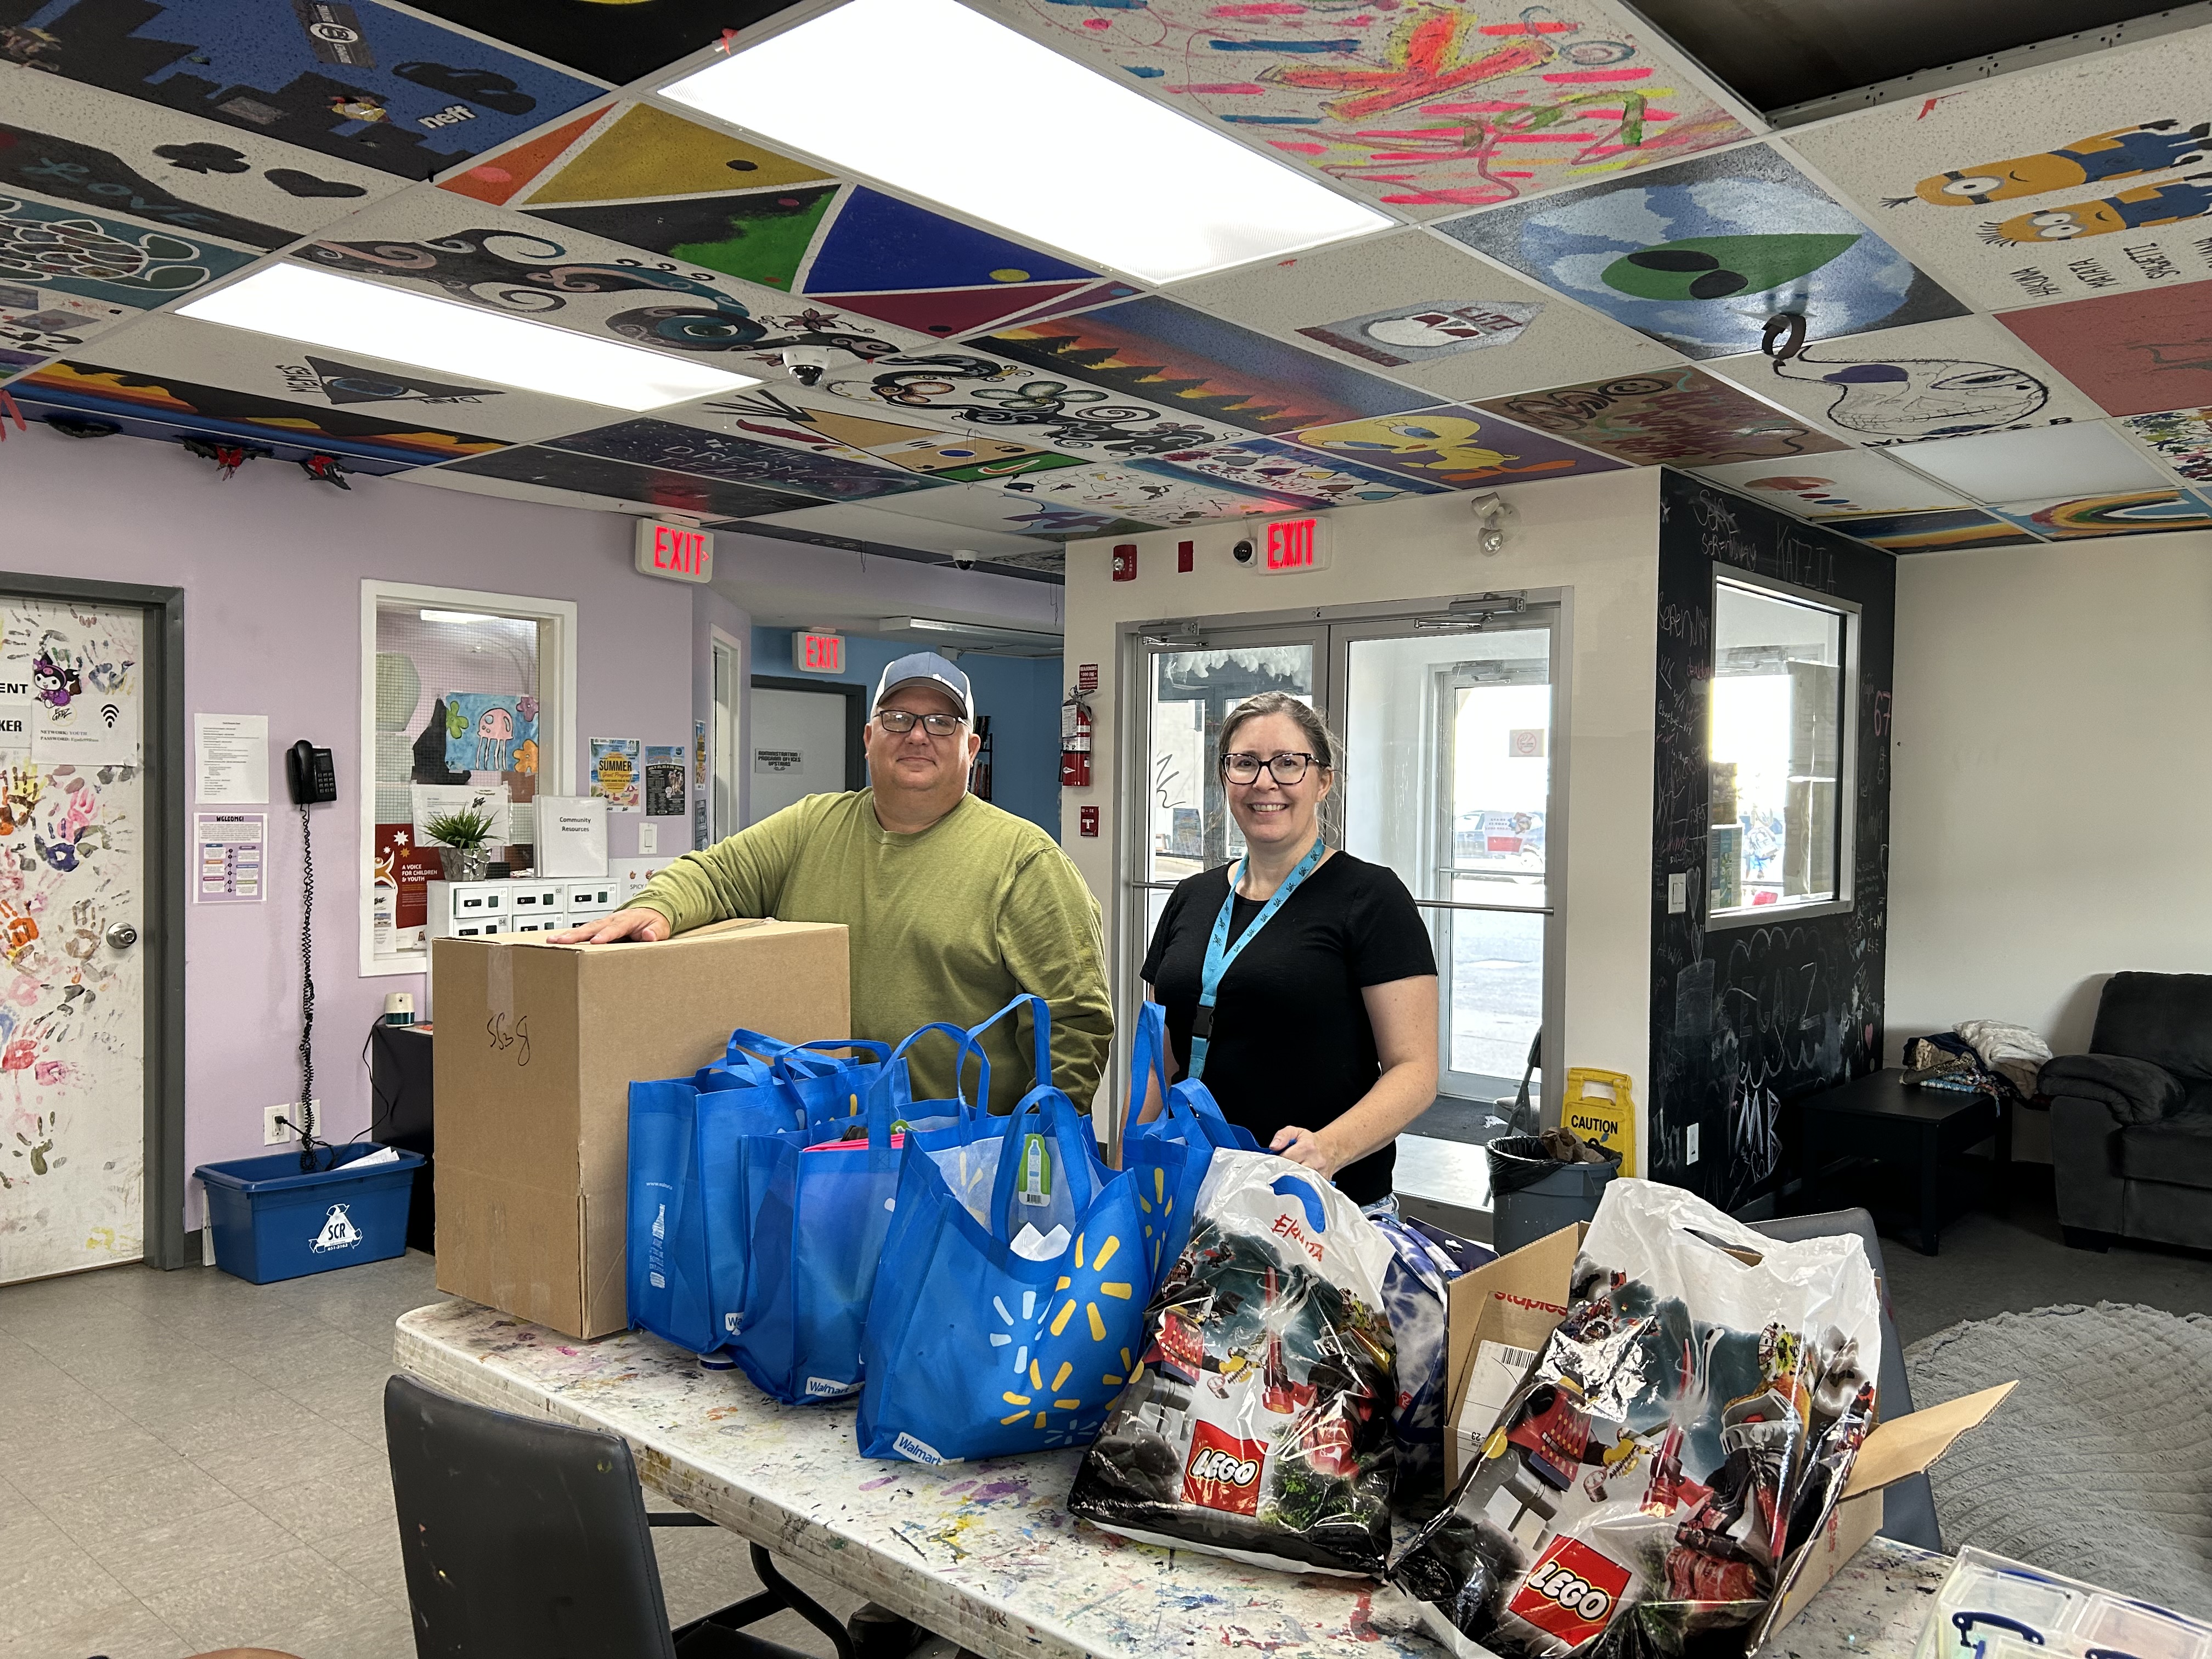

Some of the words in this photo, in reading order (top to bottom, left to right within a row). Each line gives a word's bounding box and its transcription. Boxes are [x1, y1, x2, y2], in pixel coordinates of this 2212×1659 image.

[417, 104, 477, 129] neff
[2009, 266, 2063, 297] HAKUNA
[2067, 257, 2120, 289] MATATA
[275, 365, 326, 393] MEMES
[662, 445, 814, 475] DREAM
[654, 526, 706, 575] EXIT
[1267, 518, 1317, 569] EXIT
[805, 635, 839, 669] EXIT
[1874, 690, 1892, 736] 67
[599, 760, 632, 771] SUMMER
[1571, 1114, 1618, 1134] CAUTION
[328, 1222, 346, 1240] SCR
[809, 1380, 850, 1395] Walmart
[899, 1436, 941, 1465] Walmart
[1190, 1449, 1260, 1486] LEGO
[1529, 1560, 1612, 1622] LEGO
